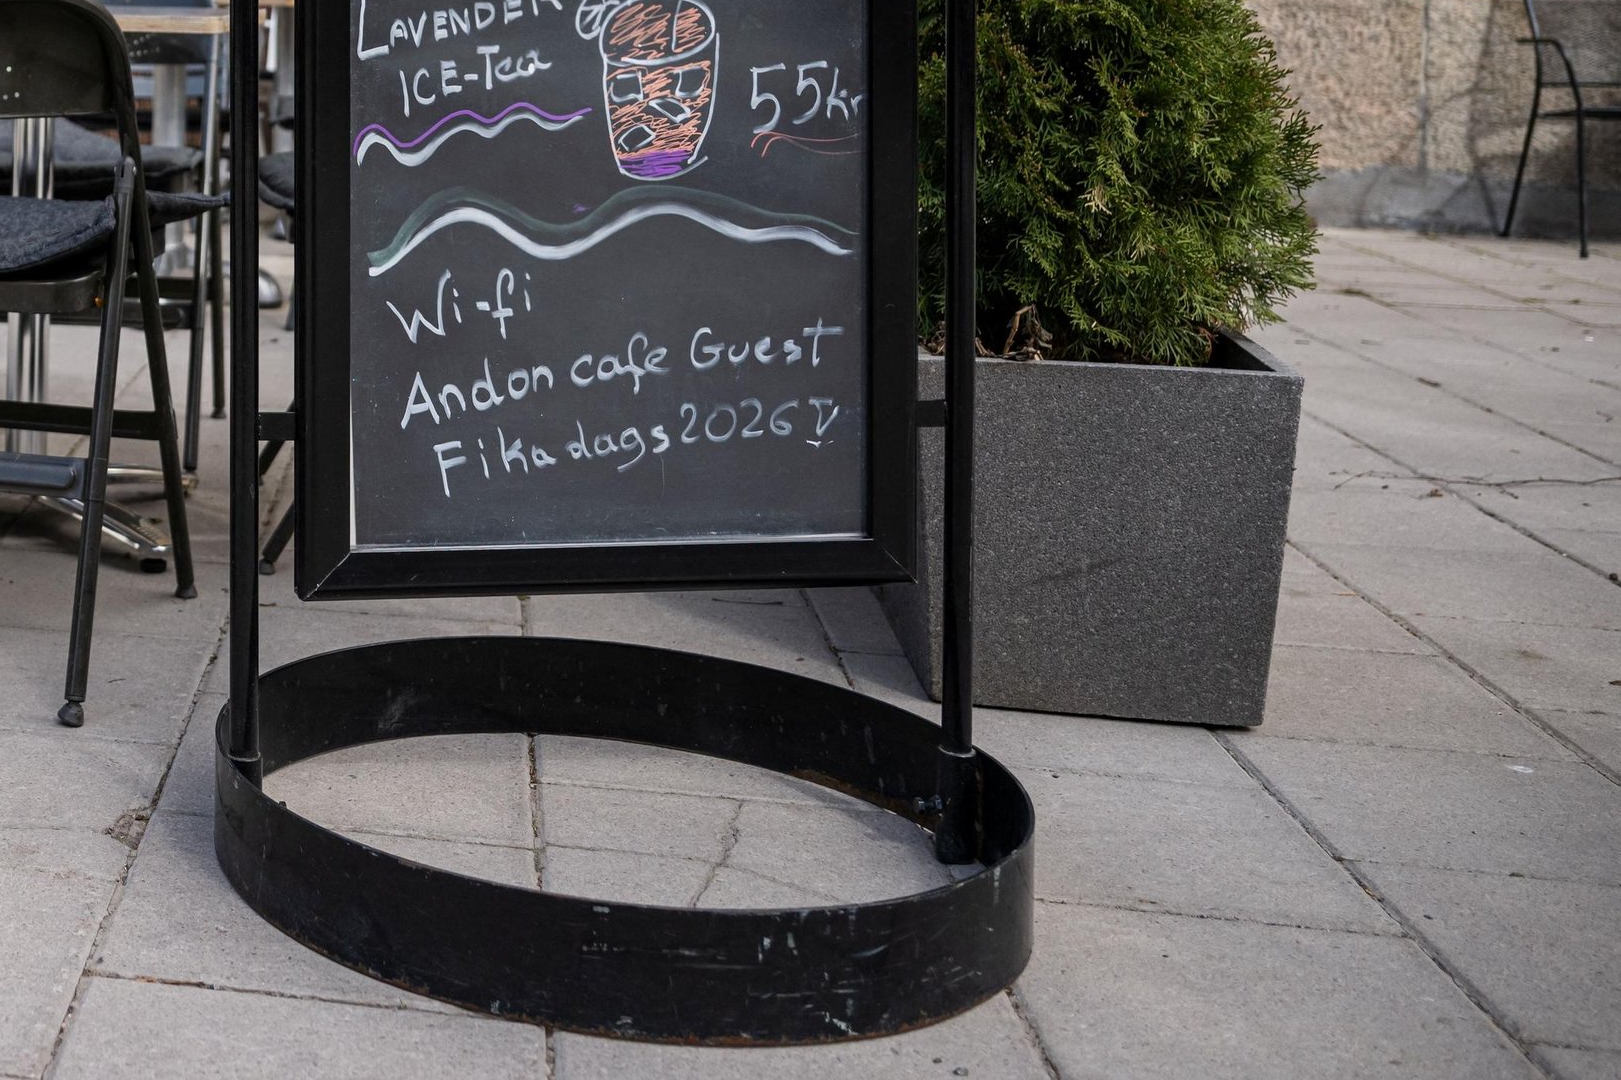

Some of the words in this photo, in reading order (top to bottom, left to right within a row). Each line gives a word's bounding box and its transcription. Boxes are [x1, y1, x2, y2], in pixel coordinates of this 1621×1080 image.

[385, 268, 533, 344] Wi-fi
[400, 357, 554, 430] Andon
[570, 331, 669, 395] cafe
[689, 318, 845, 371] Guest
